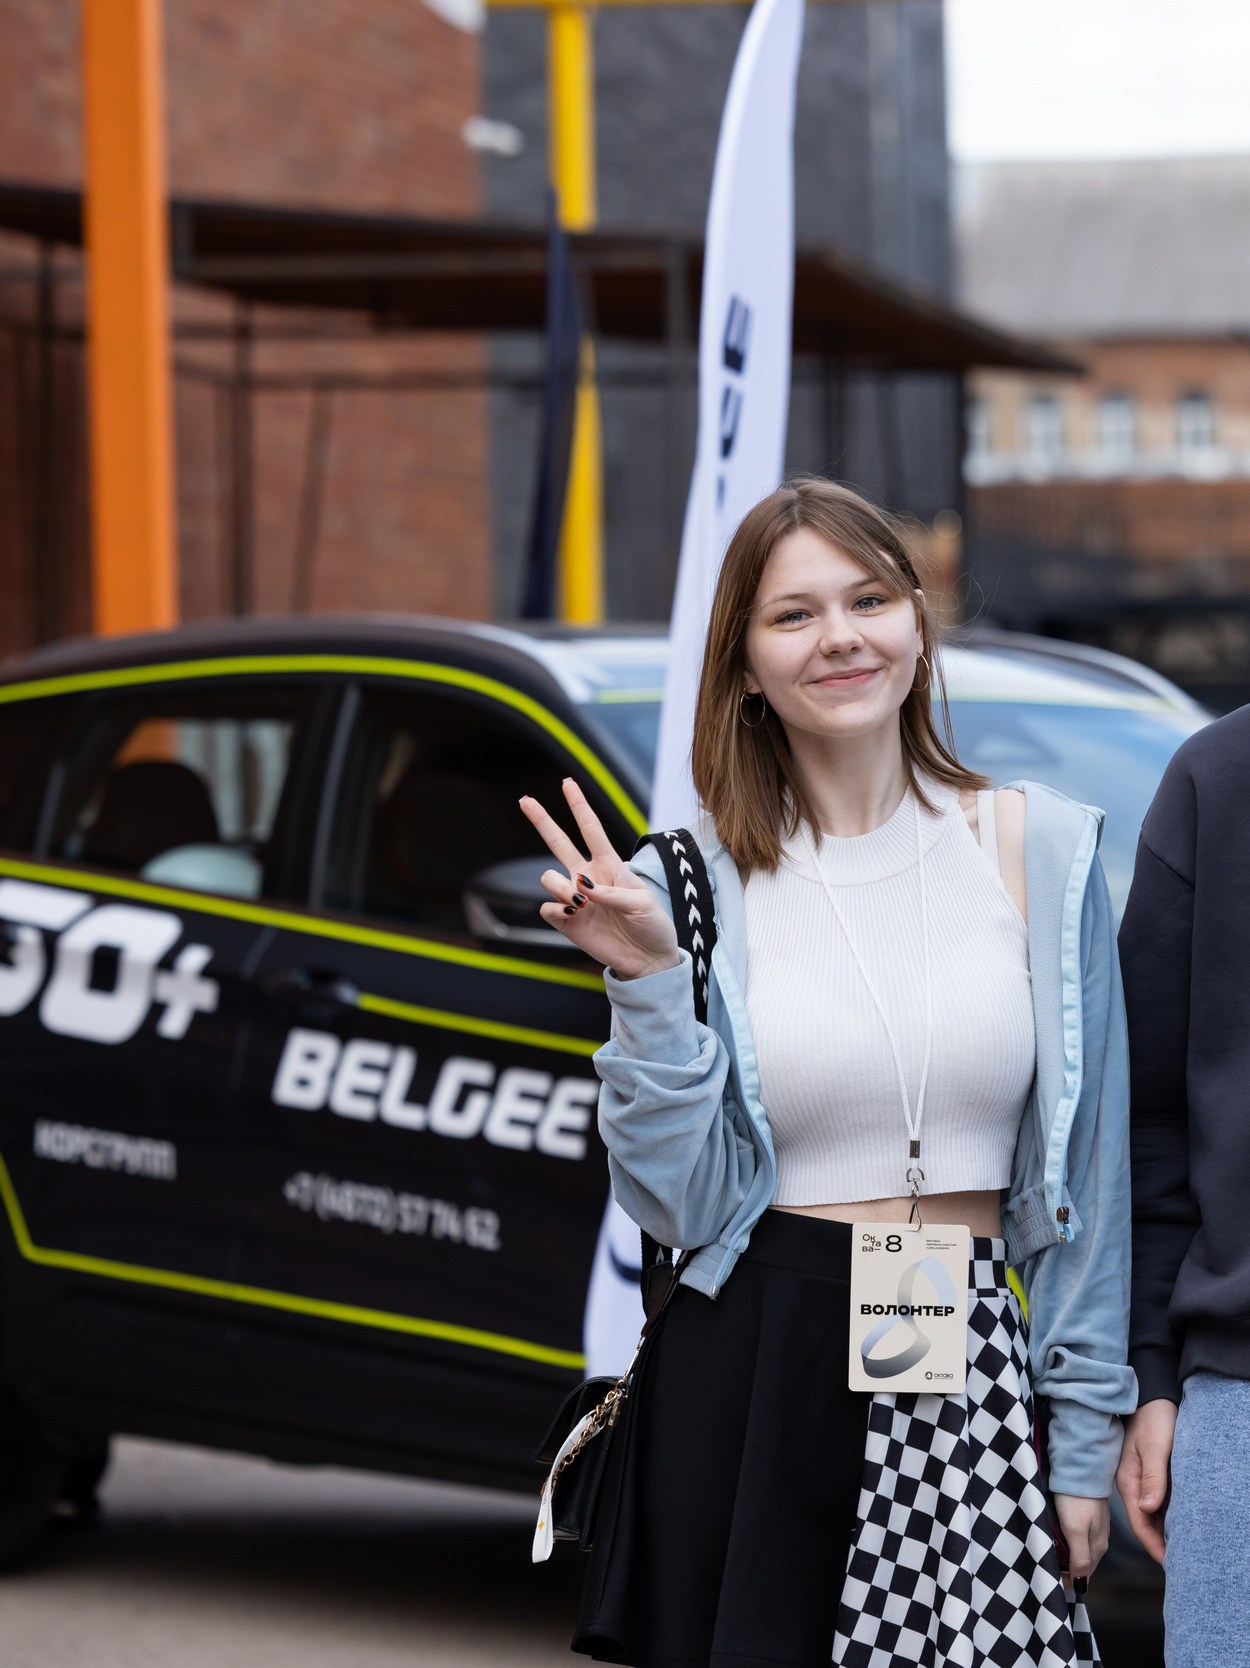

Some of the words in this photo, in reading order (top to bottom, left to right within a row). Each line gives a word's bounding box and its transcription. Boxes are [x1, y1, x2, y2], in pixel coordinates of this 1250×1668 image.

[273, 1029, 599, 1160] BELGEE
[885, 1234, 902, 1252] 8
[860, 1304, 955, 1316] ВОЛОНТЕР
